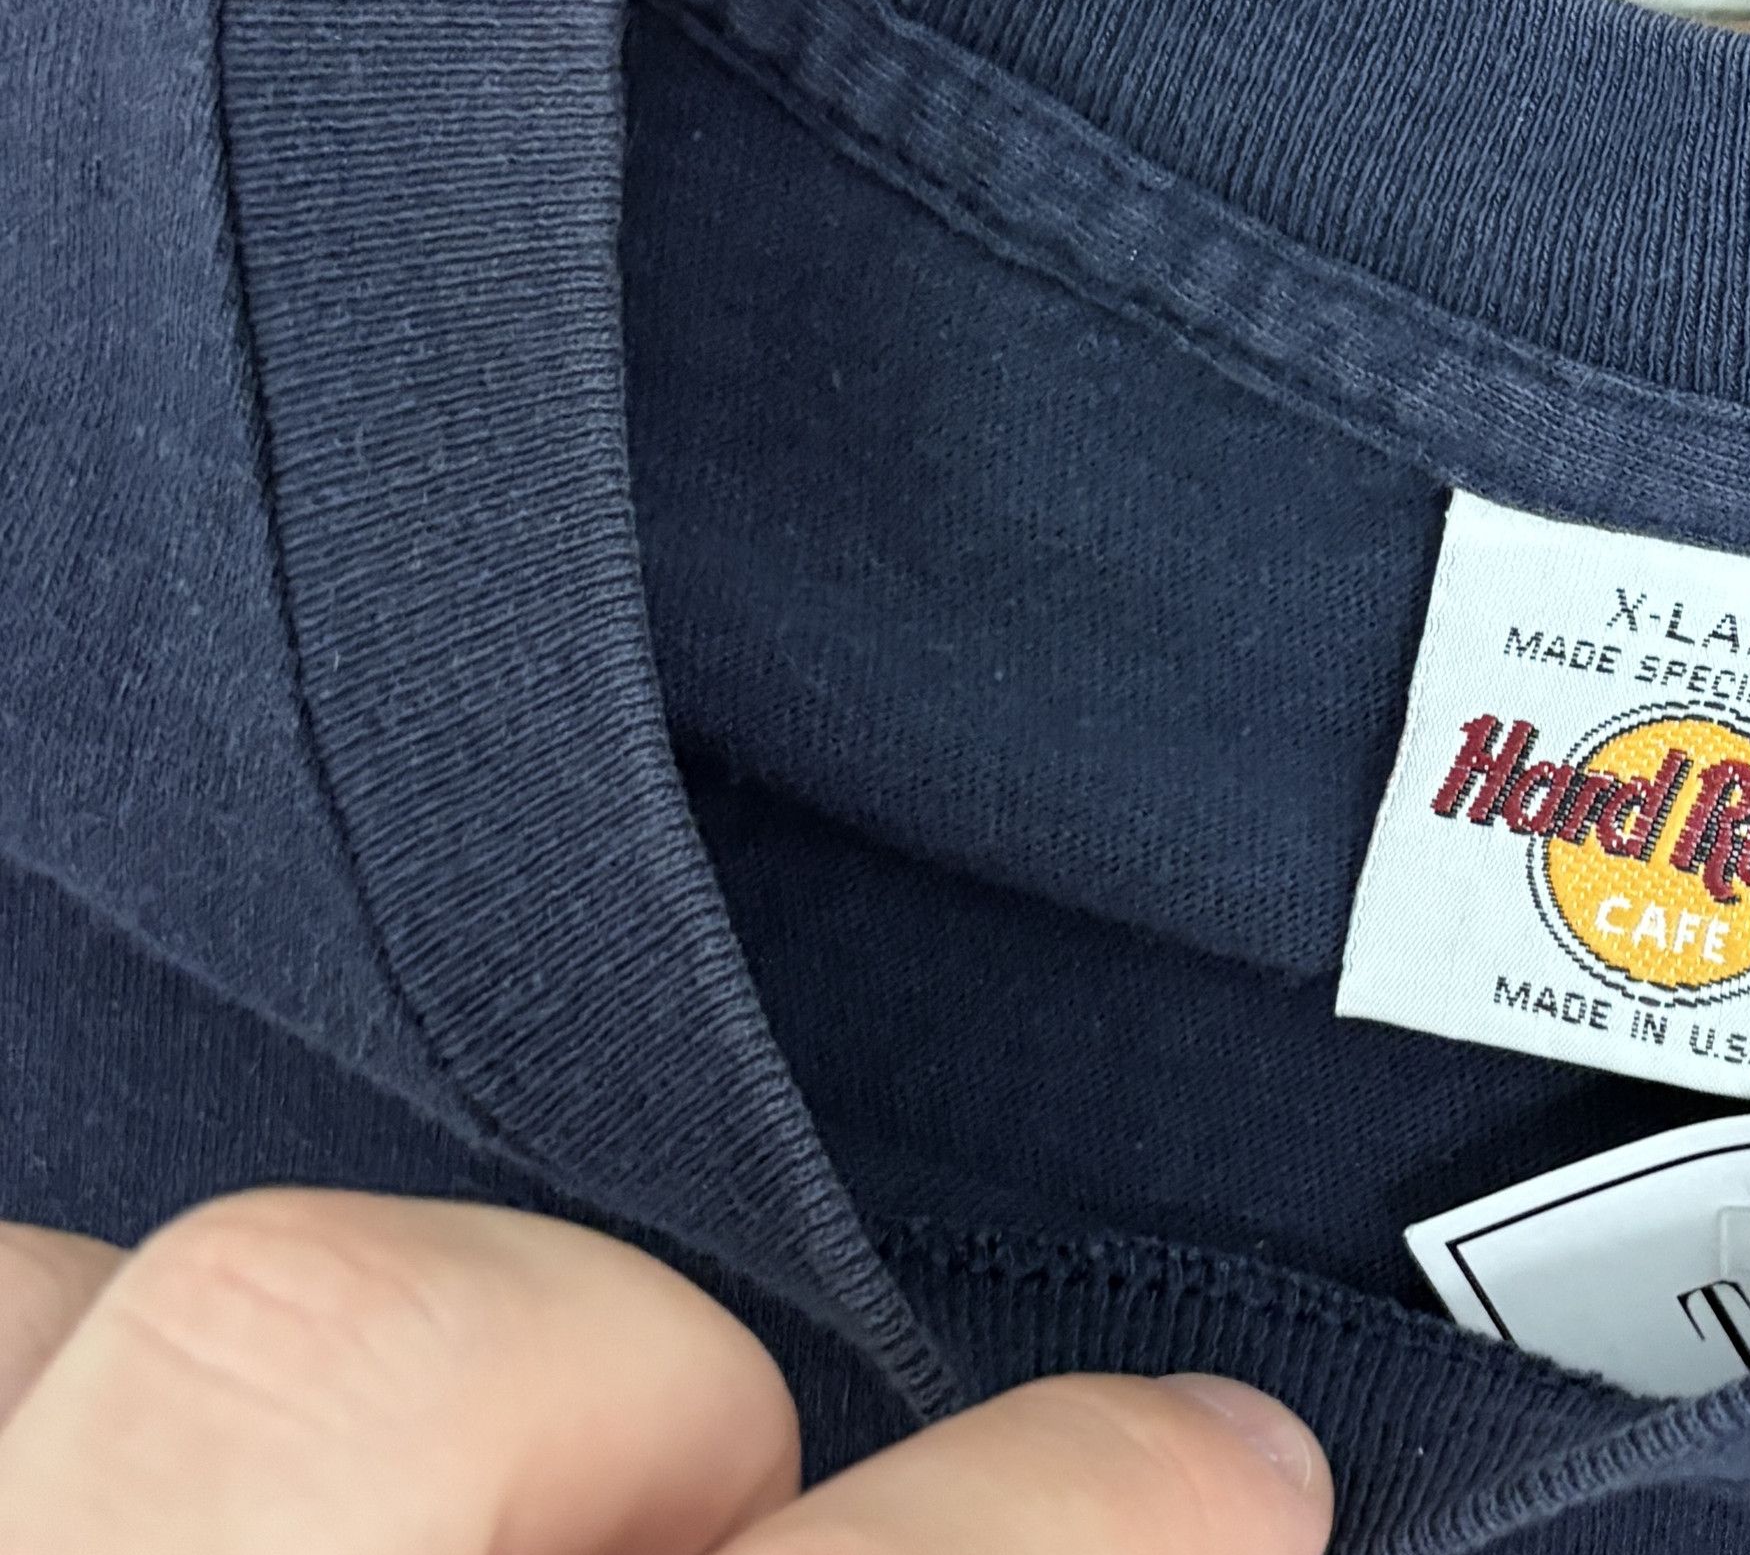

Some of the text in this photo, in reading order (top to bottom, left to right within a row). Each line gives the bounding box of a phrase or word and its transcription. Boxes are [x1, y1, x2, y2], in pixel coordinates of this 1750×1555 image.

[1504, 626, 1623, 675] MADE
[1431, 713, 1693, 862] Hard
[1596, 896, 1730, 965] CAFE
[1493, 976, 1612, 1032] MADE
[1630, 1008, 1668, 1045] IN
